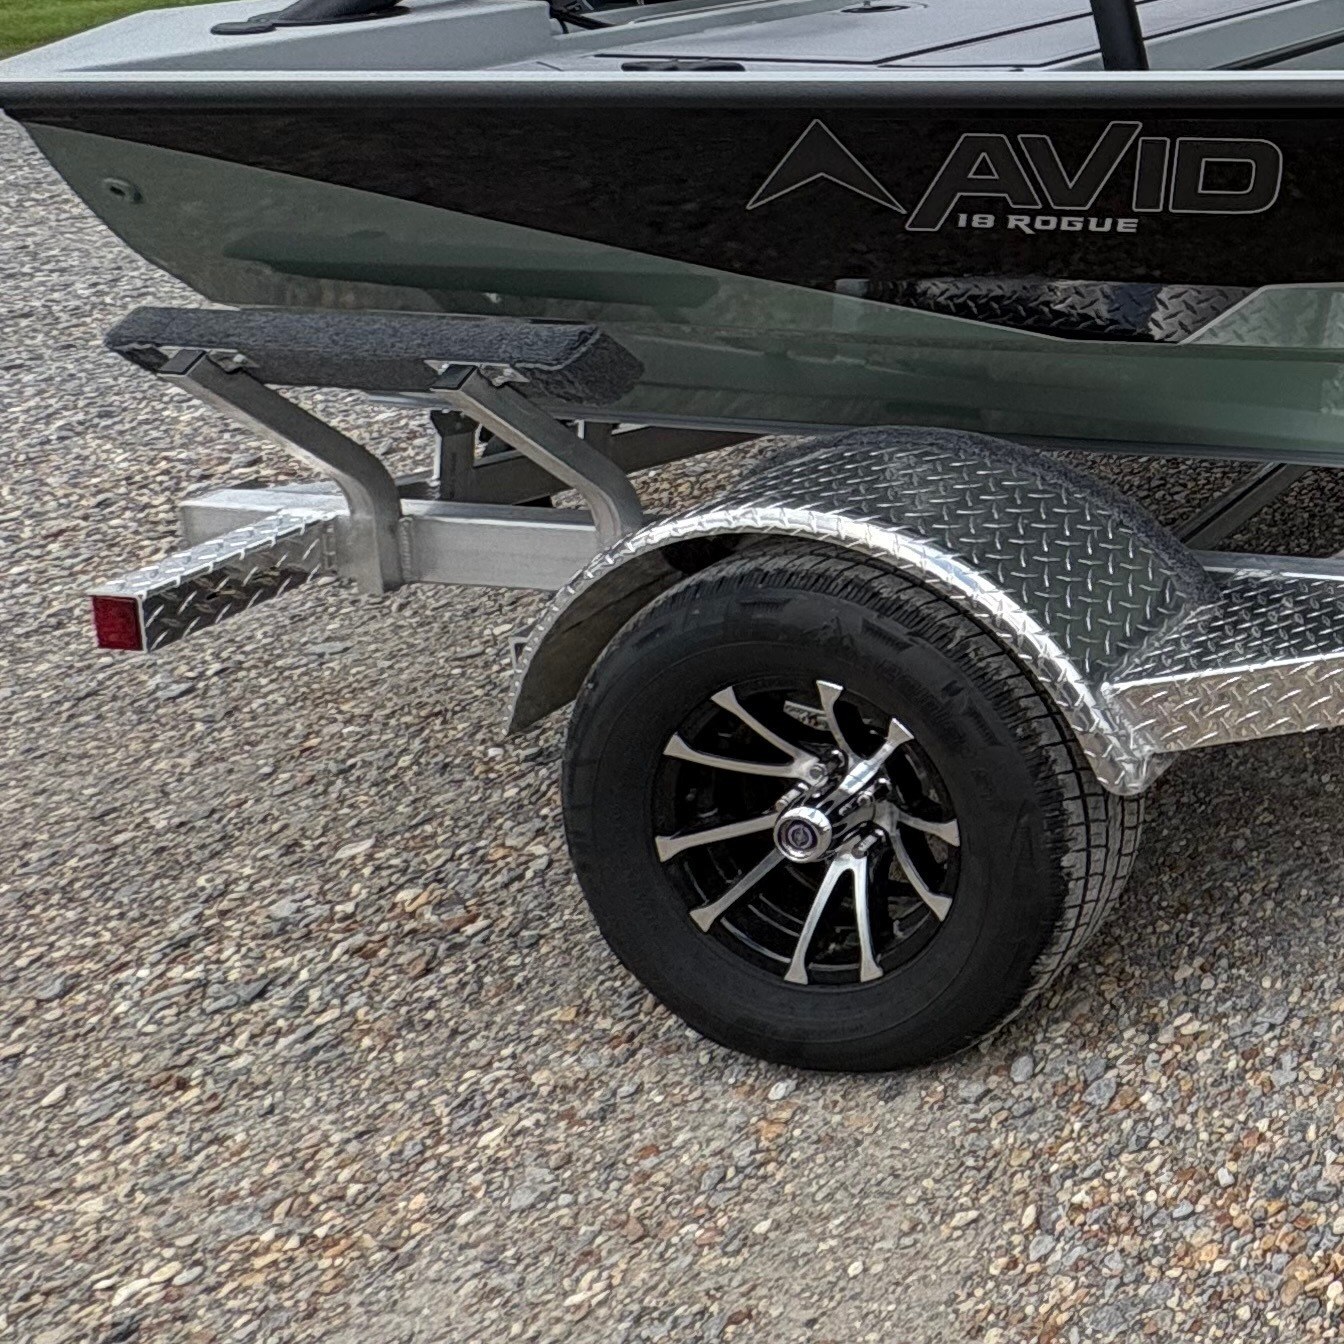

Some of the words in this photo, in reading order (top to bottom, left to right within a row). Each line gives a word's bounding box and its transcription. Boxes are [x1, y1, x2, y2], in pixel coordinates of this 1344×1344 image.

[904, 120, 1284, 232] AVID
[956, 212, 995, 230] 18
[1006, 214, 1140, 235] ROGUE
